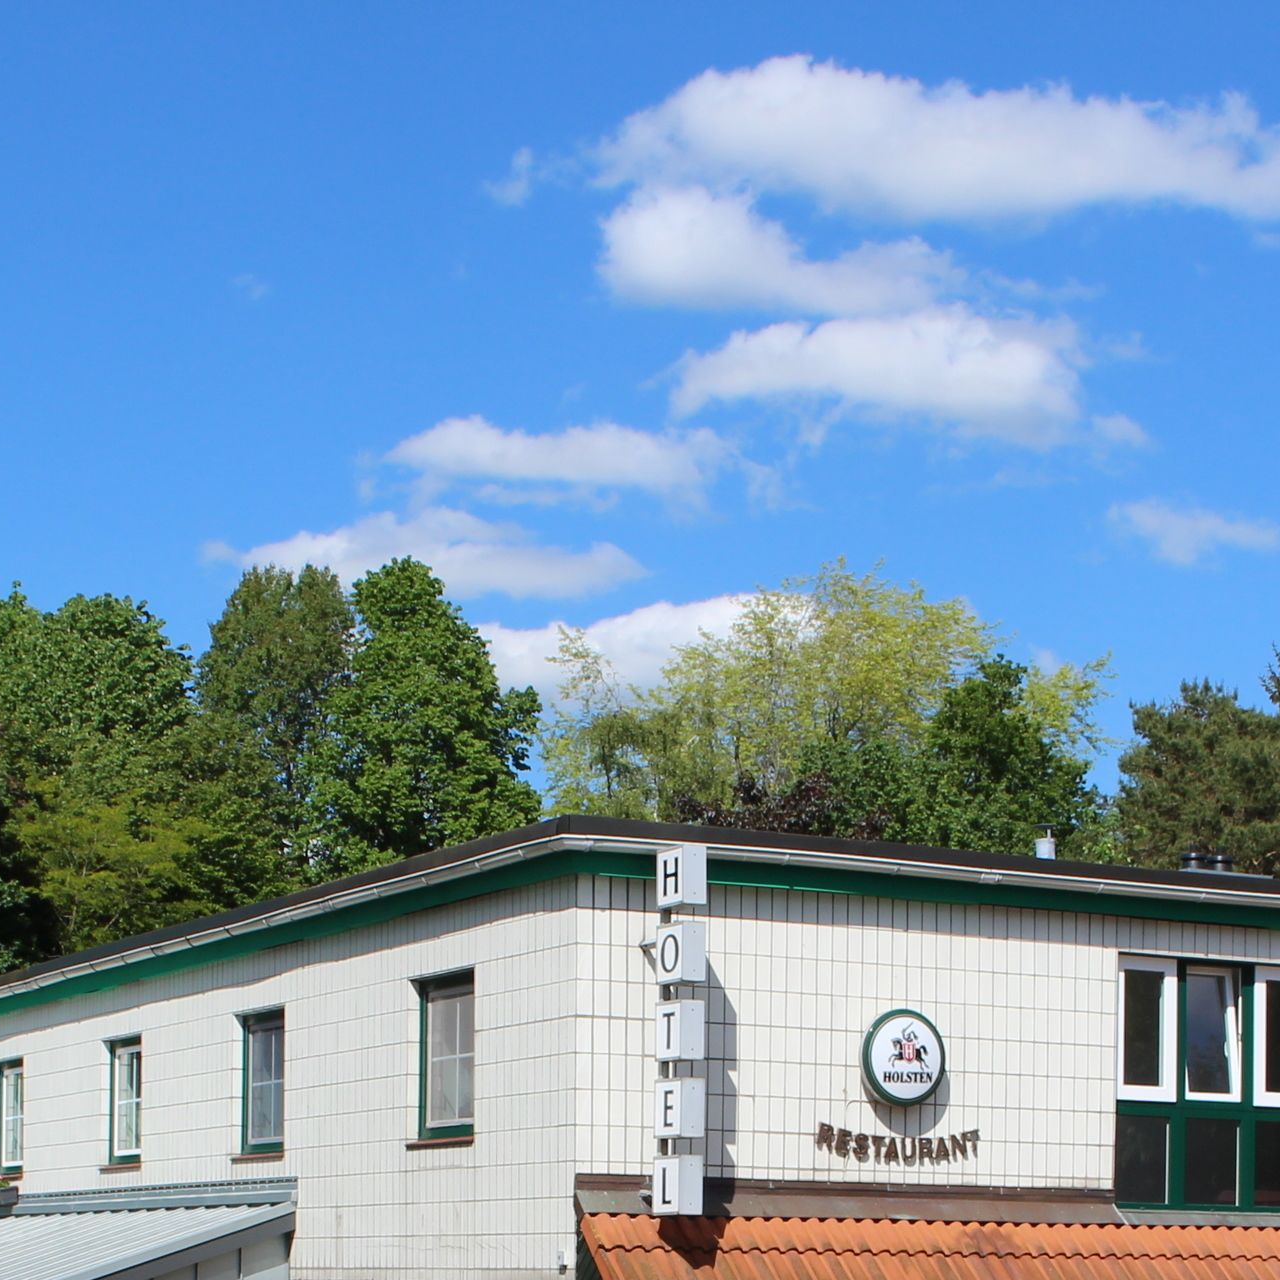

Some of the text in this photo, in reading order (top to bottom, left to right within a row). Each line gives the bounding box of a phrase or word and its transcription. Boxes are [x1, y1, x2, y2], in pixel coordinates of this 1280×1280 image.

[660, 856, 679, 1205] HOTEL
[883, 1071, 933, 1083] HOLSTEN
[817, 1122, 979, 1163] RESTAURANT
